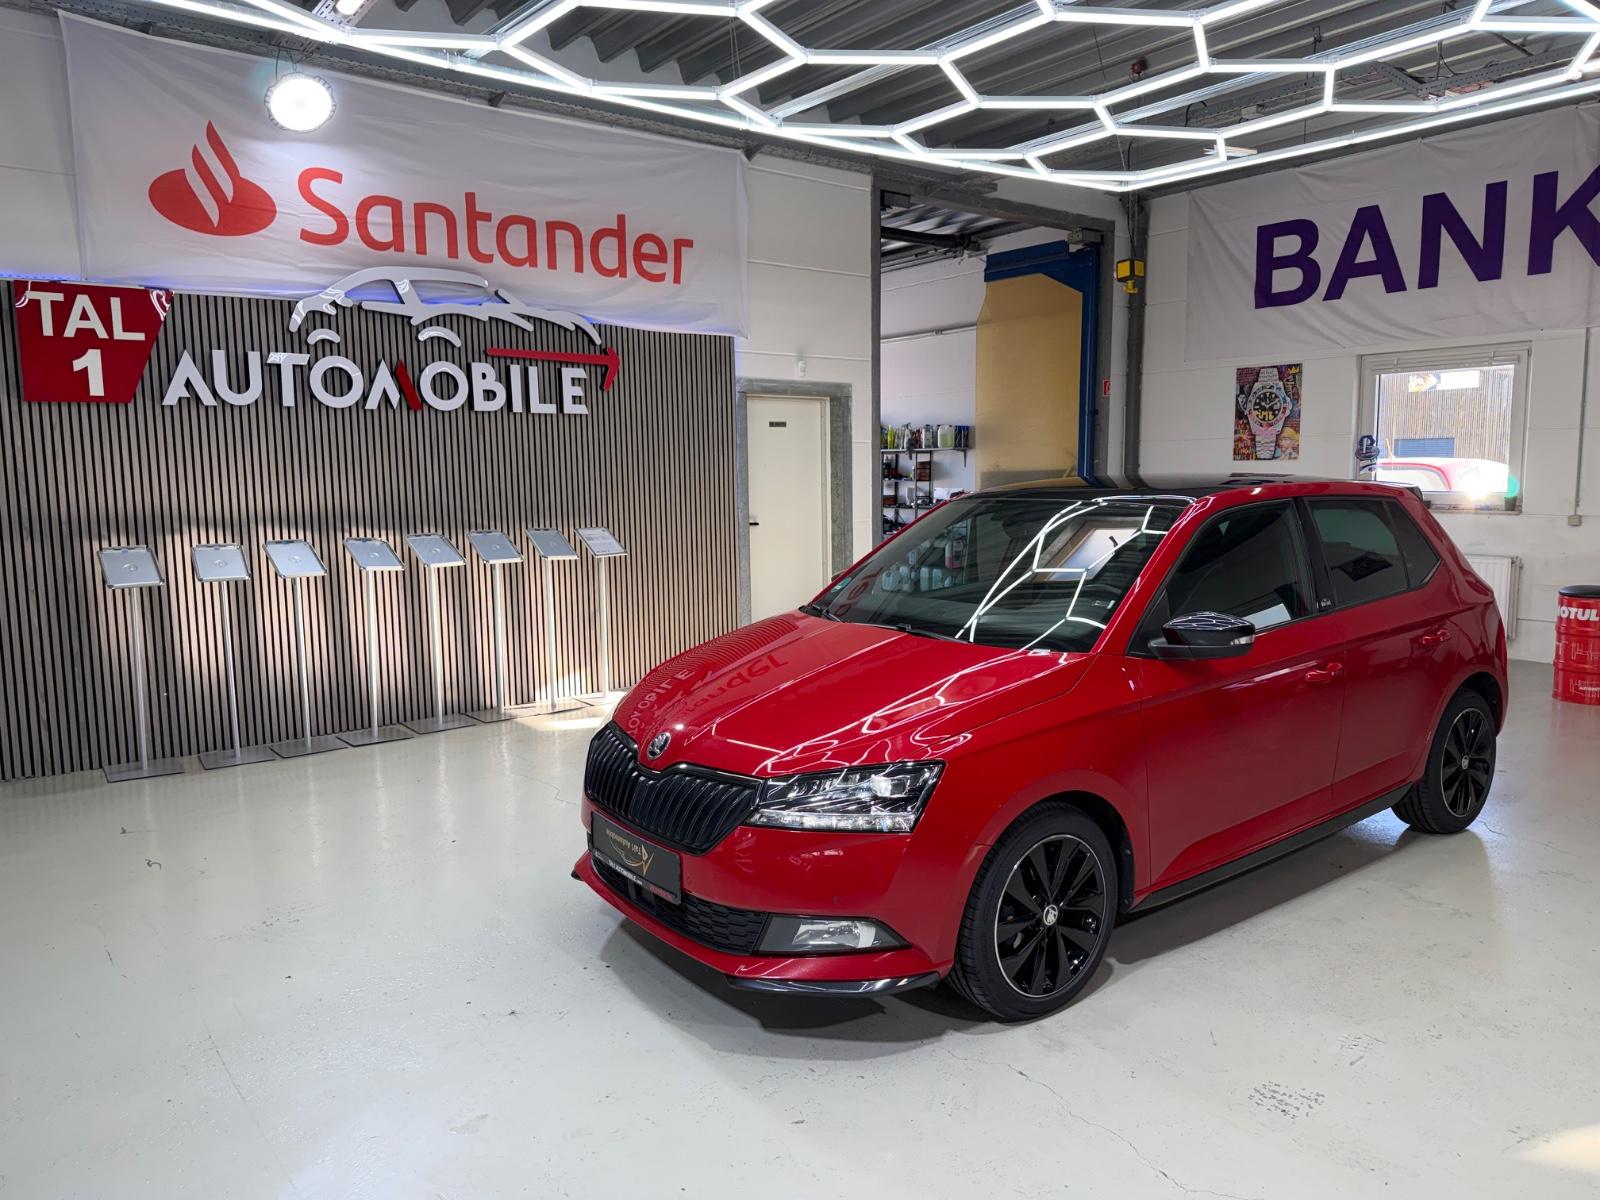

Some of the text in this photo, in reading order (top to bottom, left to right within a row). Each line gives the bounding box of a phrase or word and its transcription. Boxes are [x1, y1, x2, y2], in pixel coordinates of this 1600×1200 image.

[297, 167, 693, 284] Santander
[1254, 164, 1600, 309] BANK
[26, 290, 146, 342] TAL
[72, 348, 105, 397] 1
[162, 349, 590, 416] AUTOMOBILE
